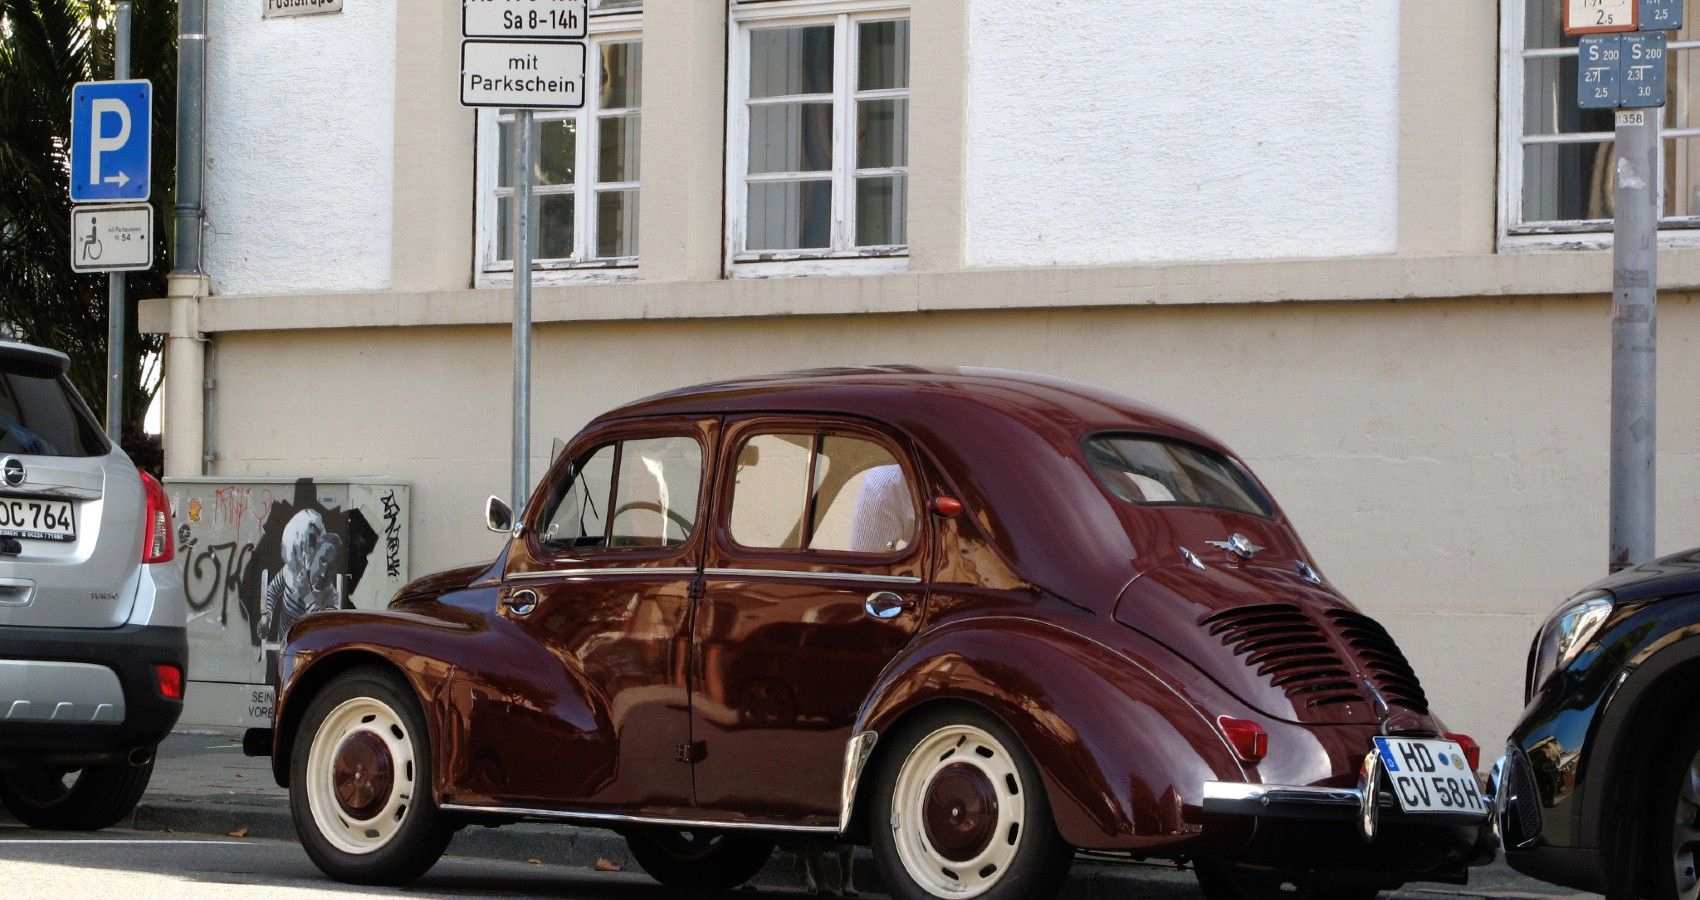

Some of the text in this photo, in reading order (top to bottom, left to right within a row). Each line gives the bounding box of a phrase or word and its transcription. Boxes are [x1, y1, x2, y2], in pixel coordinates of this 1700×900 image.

[503, 10, 578, 29] Sa 8-14h
[1589, 45, 1619, 61] S 200
[1631, 43, 1662, 60] S 200
[508, 54, 539, 70] mit
[470, 74, 575, 92] Parkschein
[90, 98, 132, 185] P
[121, 233, 131, 241] 54
[29, 503, 70, 531] 764
[1397, 742, 1436, 773] HD
[1397, 776, 1483, 810] CV 58H
